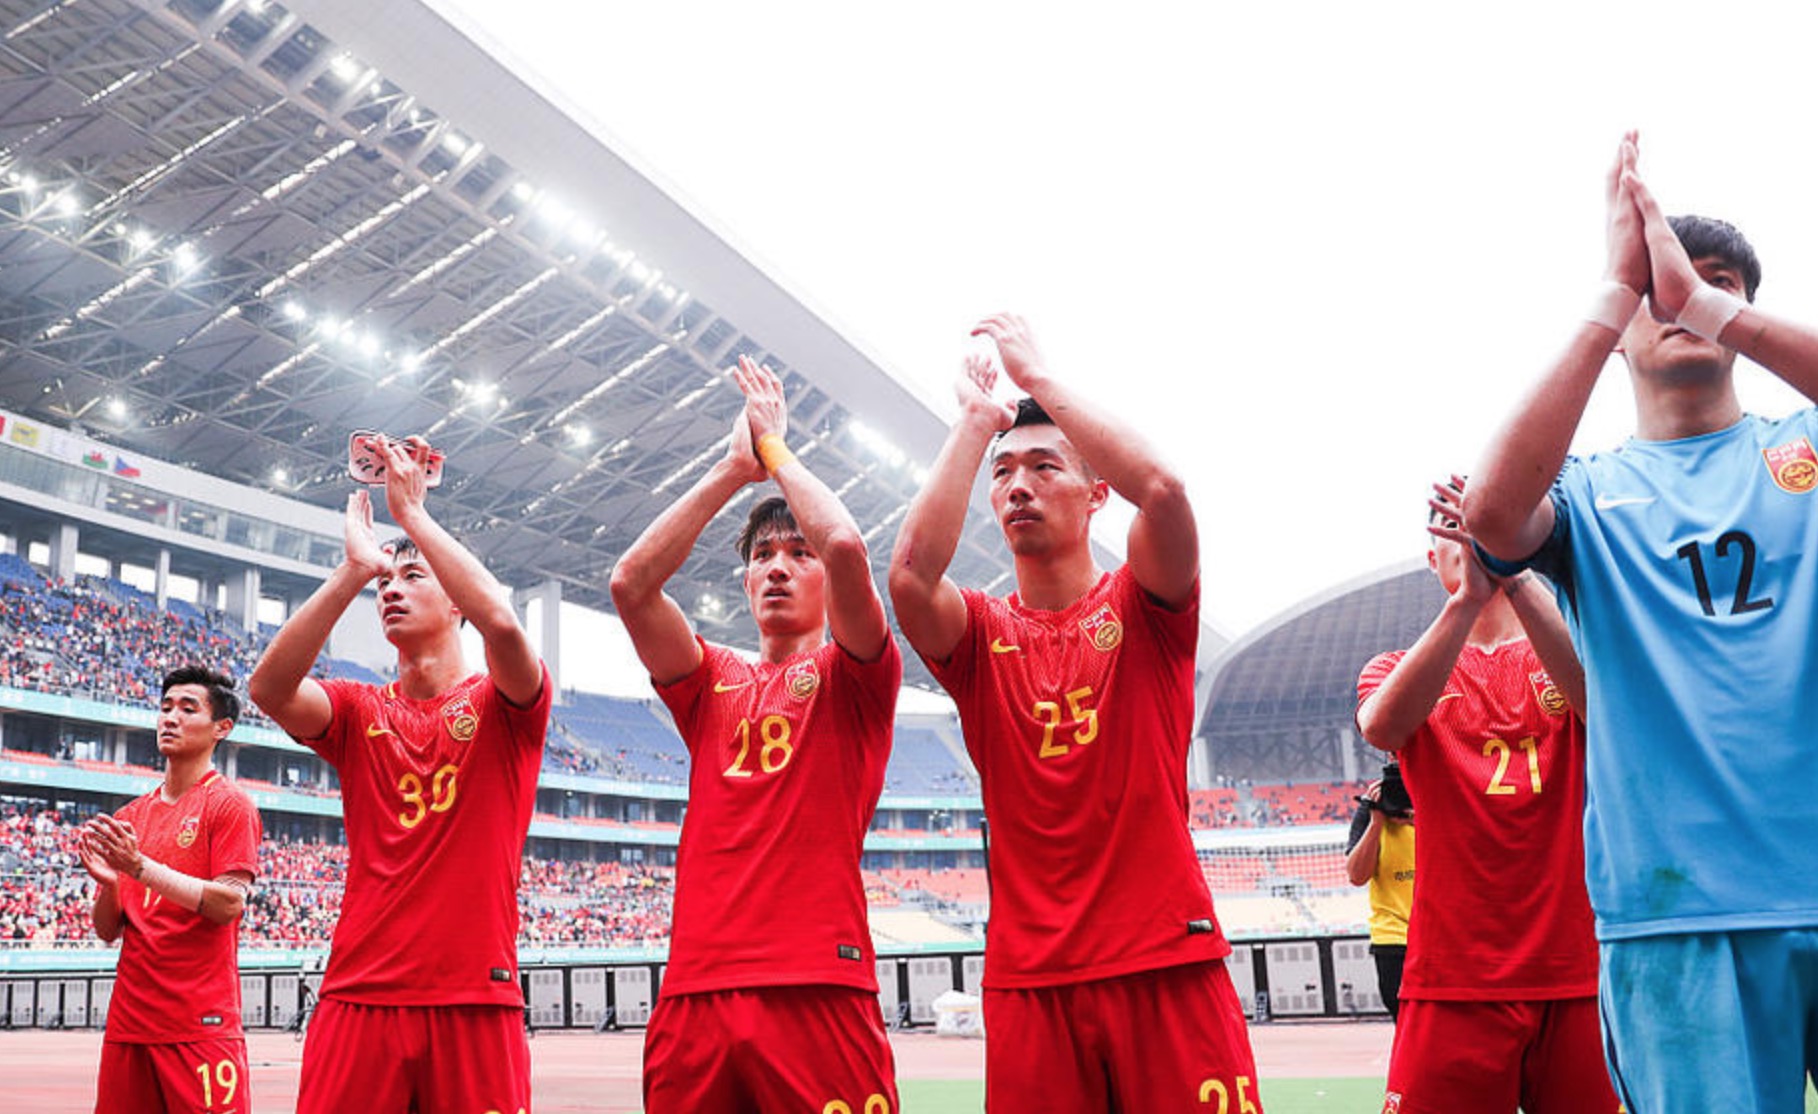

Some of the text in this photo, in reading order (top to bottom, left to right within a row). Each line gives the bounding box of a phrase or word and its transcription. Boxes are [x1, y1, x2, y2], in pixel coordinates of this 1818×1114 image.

[1677, 530, 1774, 617] 12
[722, 715, 793, 777] 28
[1033, 686, 1099, 758] 25
[398, 764, 459, 829] 30
[1482, 735, 1542, 795] 21
[197, 1059, 238, 1108] 19
